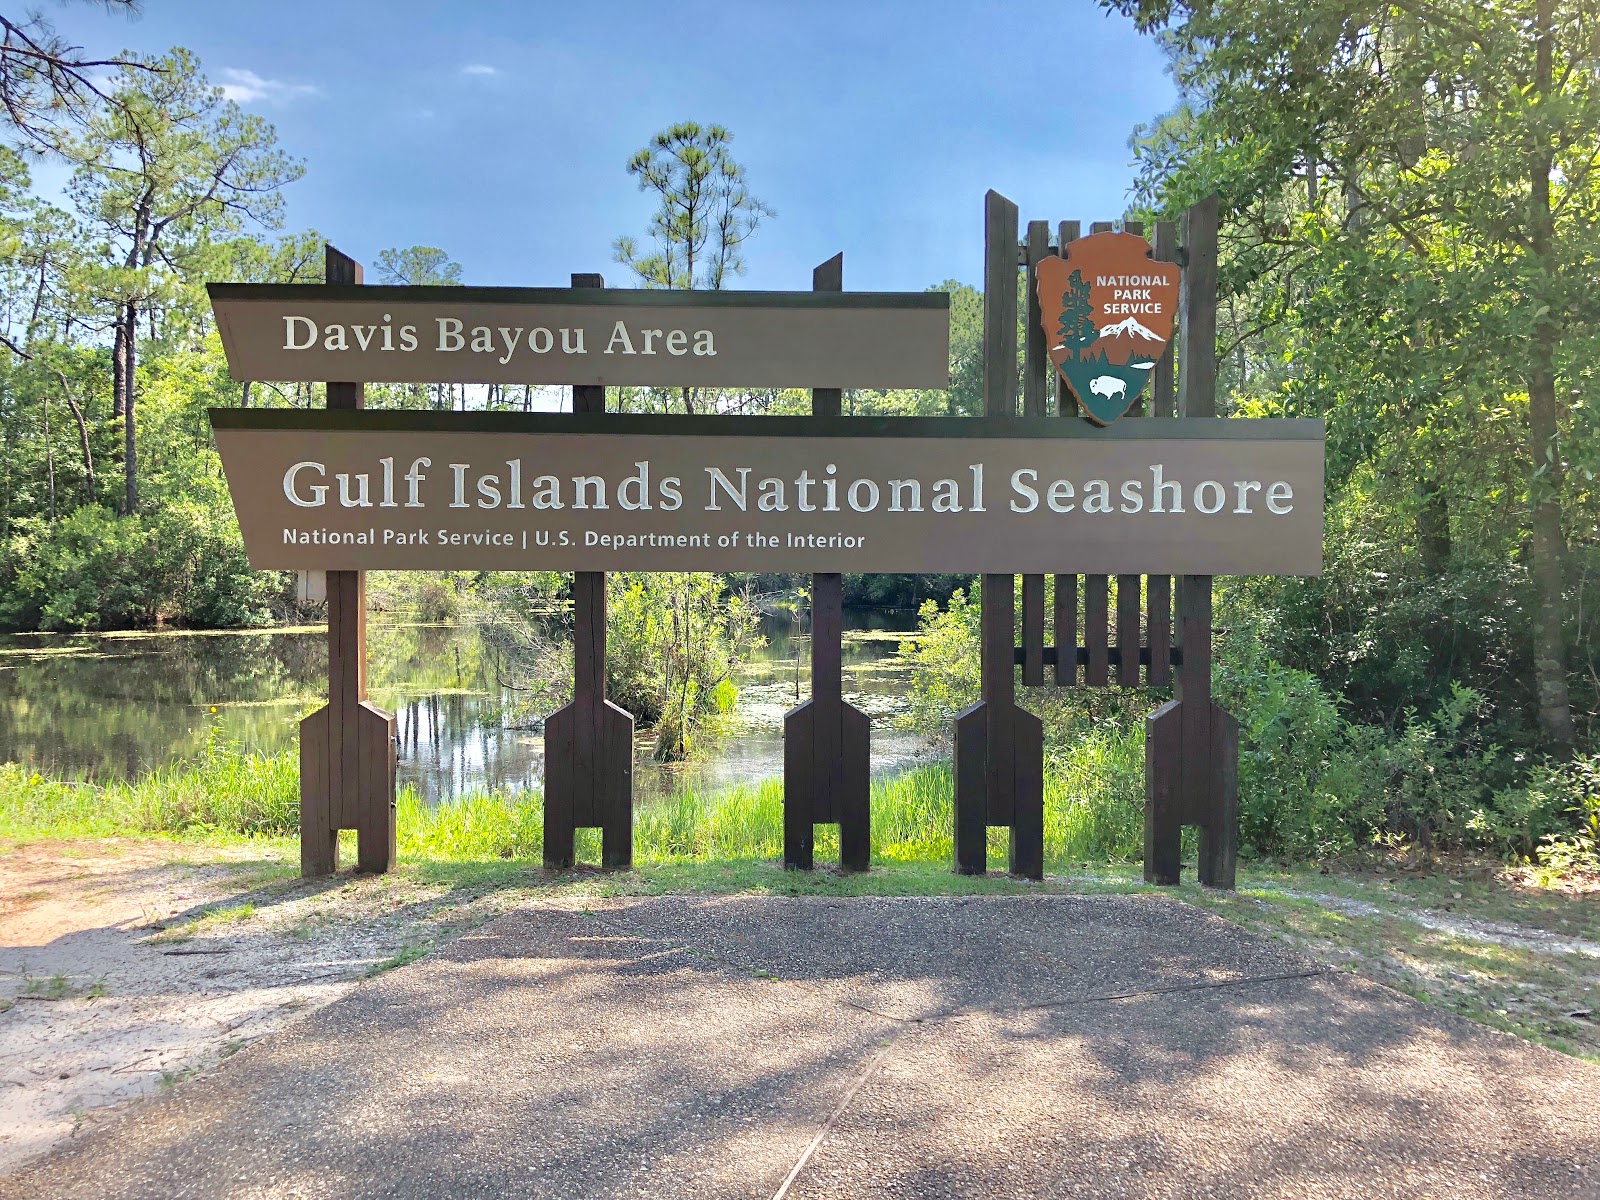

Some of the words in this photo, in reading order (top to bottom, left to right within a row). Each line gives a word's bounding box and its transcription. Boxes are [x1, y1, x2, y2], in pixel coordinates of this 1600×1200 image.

[1096, 275, 1170, 287] NATIONAL
[1114, 289, 1151, 300] PARK
[1103, 302, 1162, 315] SERVICE
[282, 313, 418, 352] Davis
[435, 317, 588, 365] Bayou
[603, 320, 718, 356] Area
[283, 456, 432, 508] Gulf
[448, 458, 683, 511] Islands
[704, 463, 987, 513] National
[1010, 463, 1294, 515] Seashore
[283, 527, 374, 545] National
[383, 528, 429, 545] Park
[437, 529, 514, 546] Service
[535, 530, 576, 546] U.S.
[585, 530, 711, 551] Department
[717, 530, 740, 548] of
[745, 531, 780, 548] the
[787, 532, 865, 548] Interior
